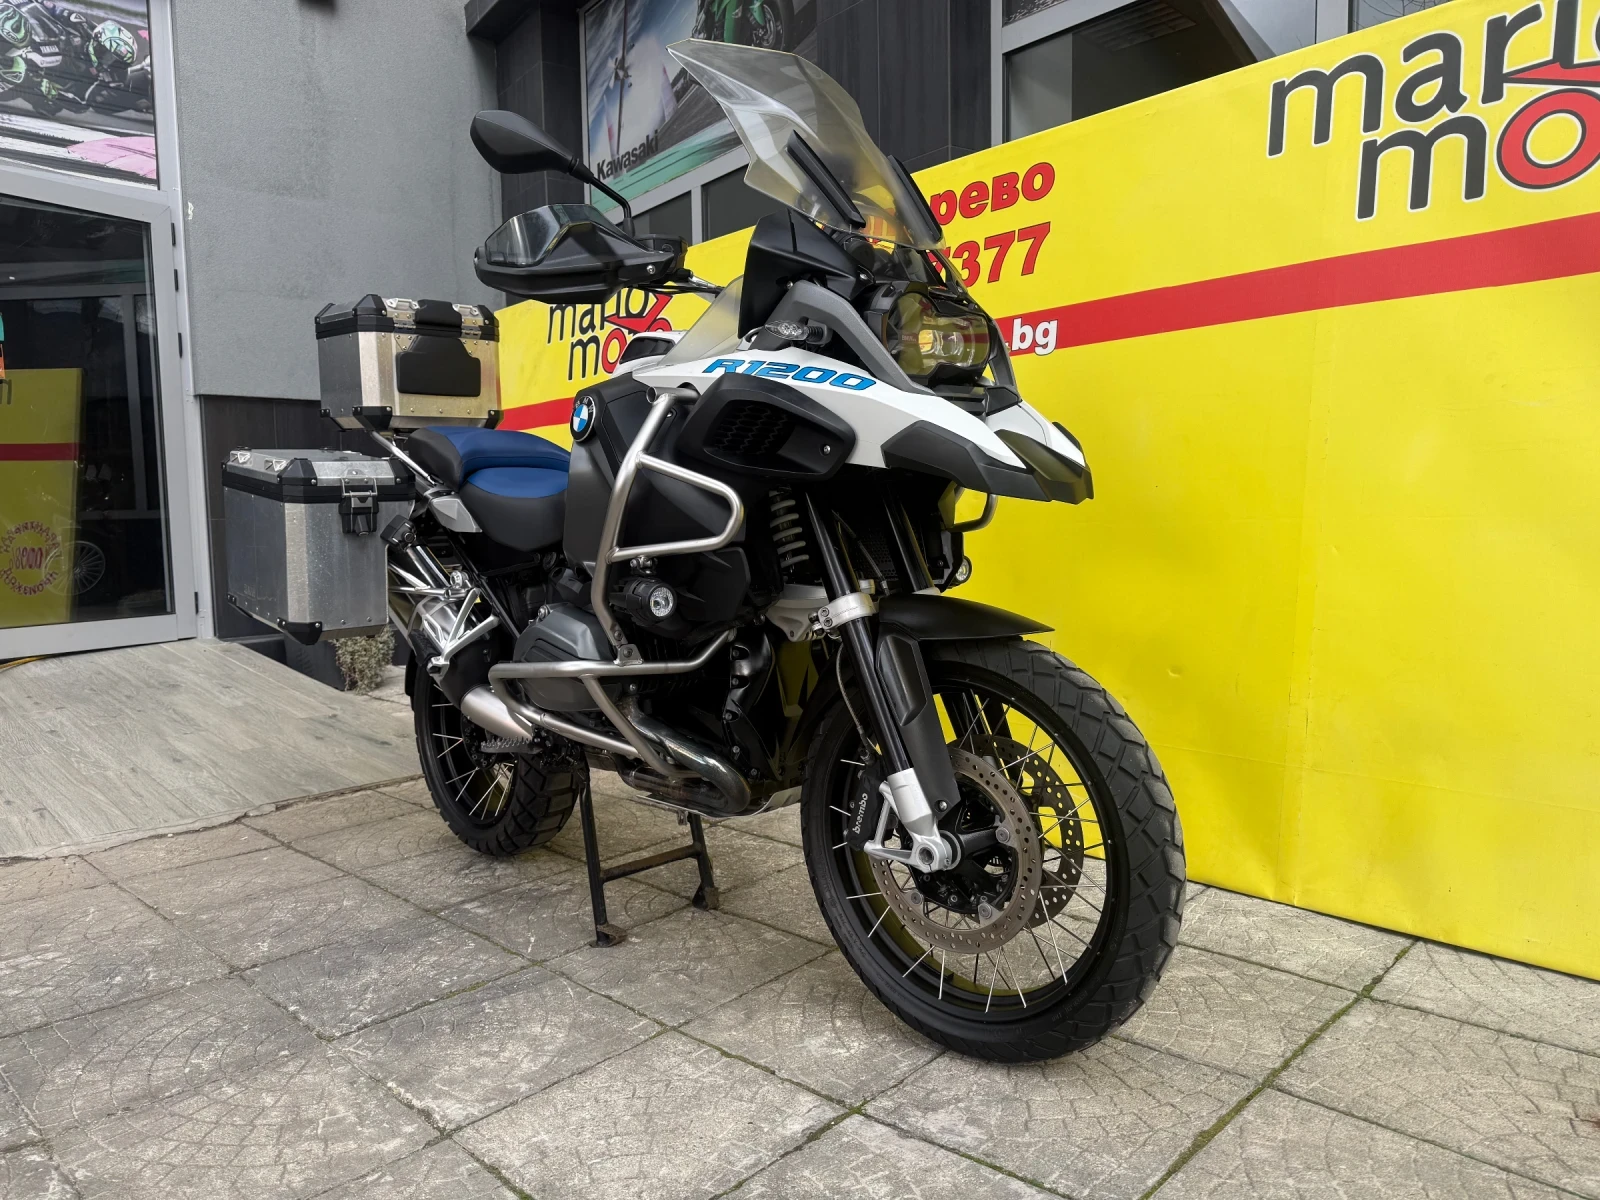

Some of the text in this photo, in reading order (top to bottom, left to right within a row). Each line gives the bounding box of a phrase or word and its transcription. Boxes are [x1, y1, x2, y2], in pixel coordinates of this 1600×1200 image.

[1267, 0, 1600, 157] mari
[596, 129, 659, 182] Kawasaki
[702, 358, 877, 391] R1200
[852, 792, 868, 834] brembo
